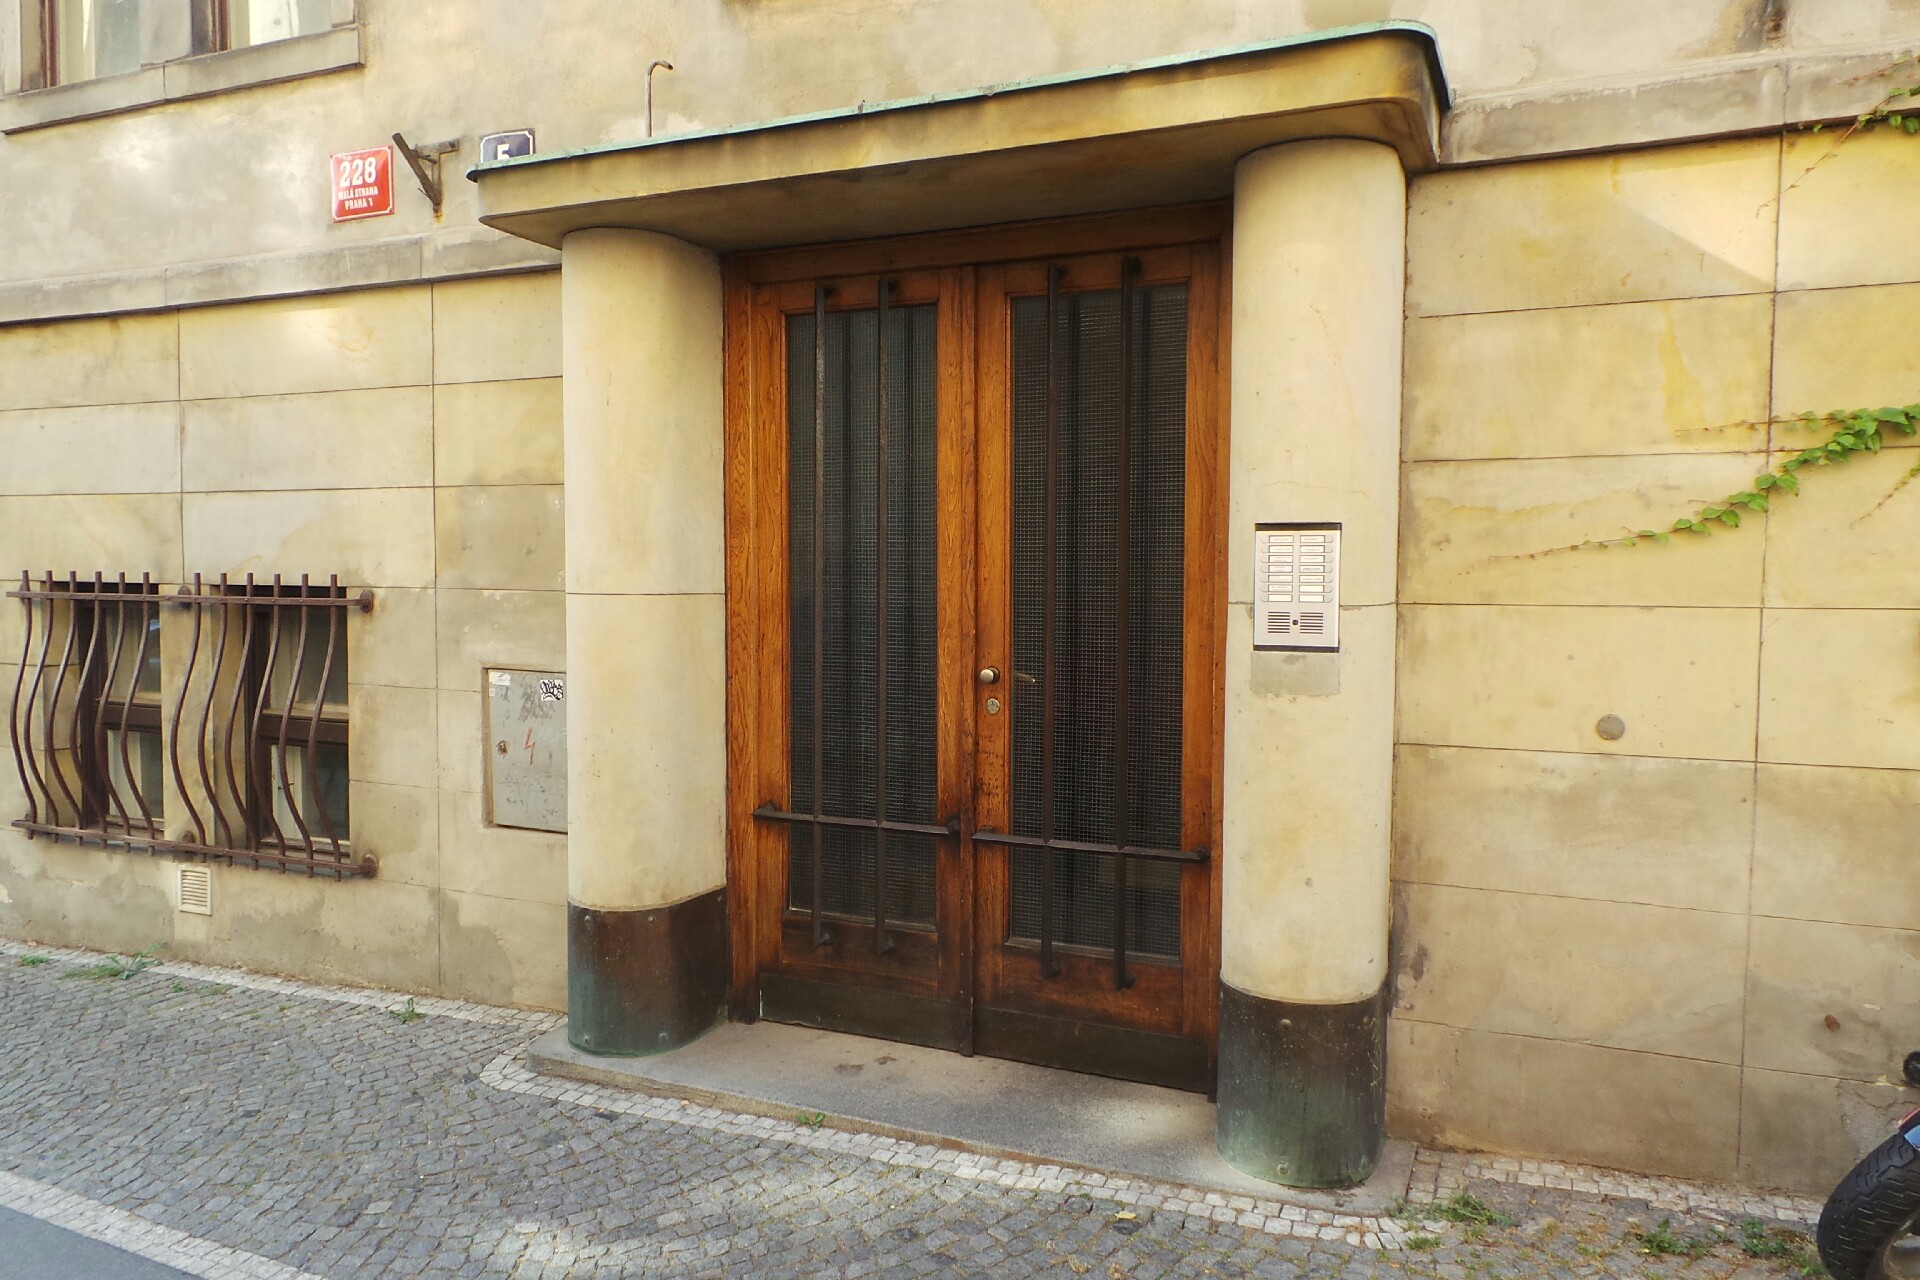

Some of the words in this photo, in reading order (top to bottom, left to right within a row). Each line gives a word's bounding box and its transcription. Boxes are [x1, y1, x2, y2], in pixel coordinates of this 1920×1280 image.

[497, 144, 510, 160] 5
[340, 157, 376, 187] 228
[355, 186, 378, 197] STRANA
[345, 198, 368, 210] PRAHA
[368, 198, 373, 206] 1
